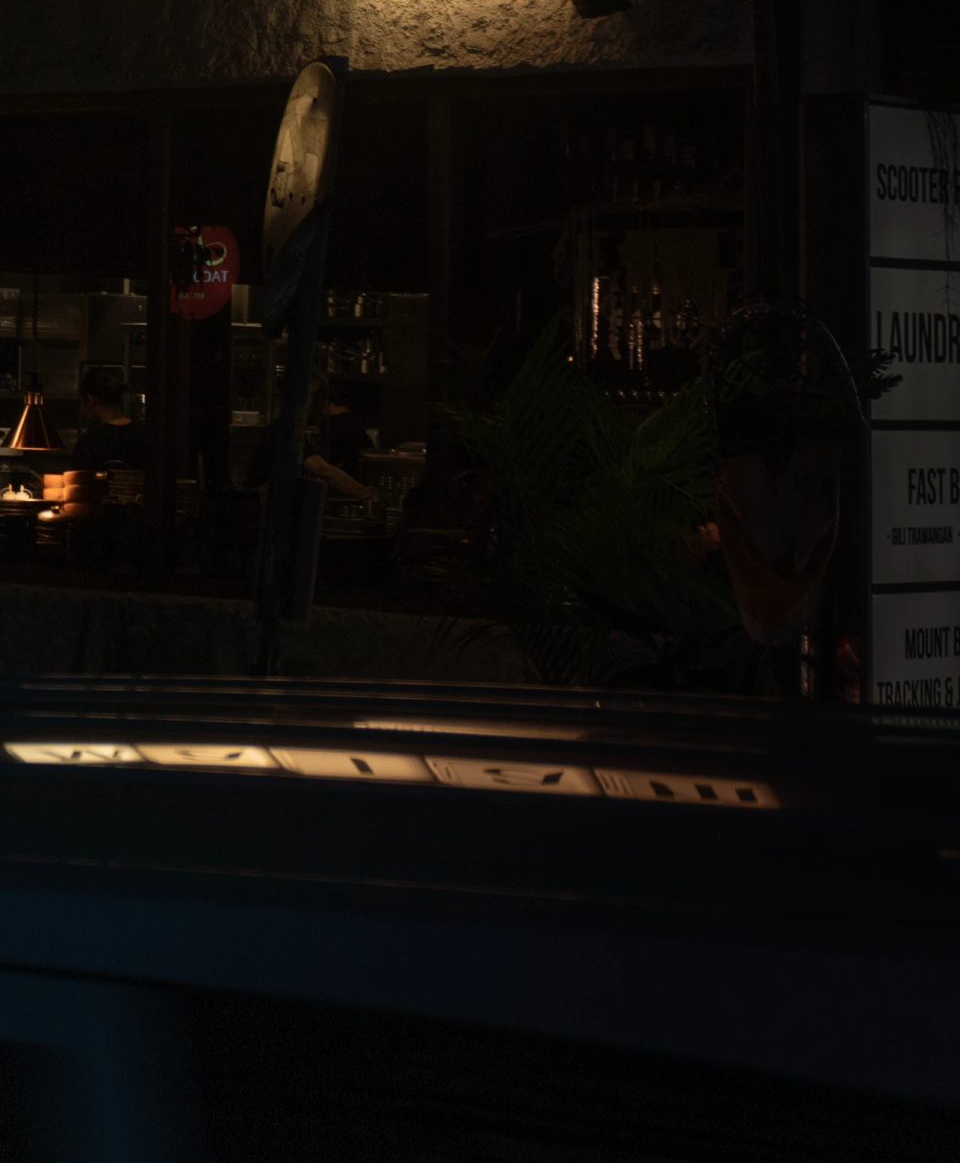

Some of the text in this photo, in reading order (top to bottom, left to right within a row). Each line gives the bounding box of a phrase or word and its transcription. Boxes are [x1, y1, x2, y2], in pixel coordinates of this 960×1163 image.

[876, 162, 950, 205] SCOOTER
[908, 467, 946, 506] FAST
[904, 626, 951, 660] MOUNT
[877, 677, 942, 710] TRACKING
[945, 676, 954, 708] &
